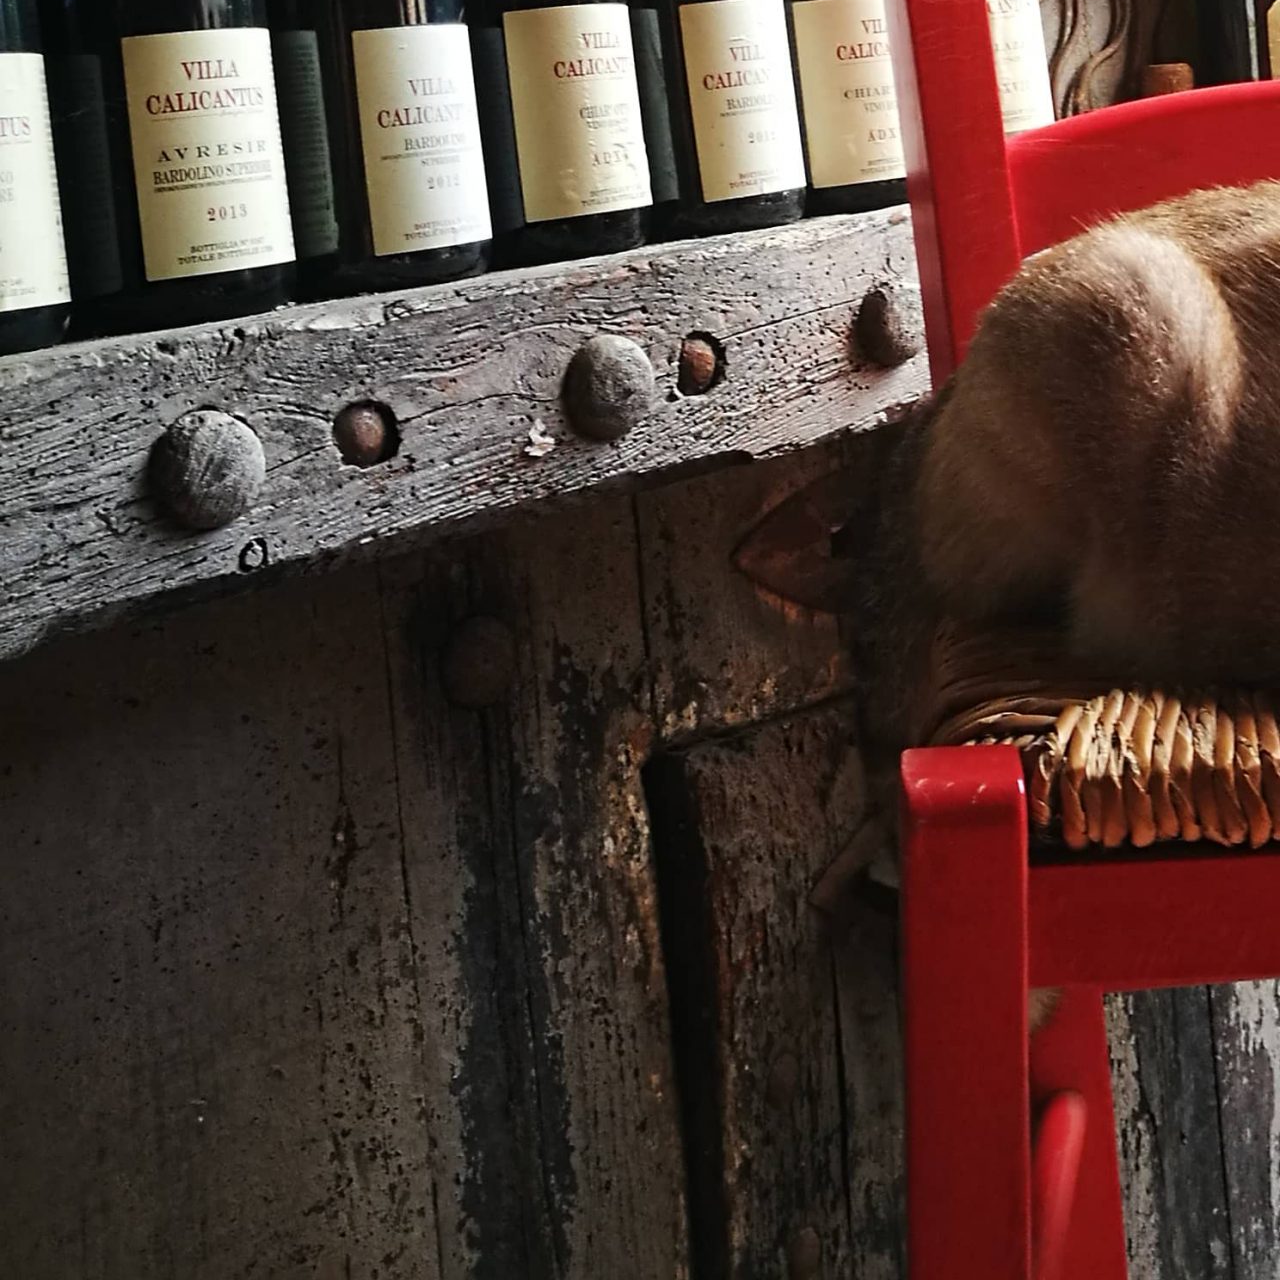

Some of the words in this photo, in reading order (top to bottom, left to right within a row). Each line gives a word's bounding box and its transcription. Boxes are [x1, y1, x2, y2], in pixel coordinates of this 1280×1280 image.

[180, 59, 240, 81] VILLA
[146, 86, 265, 115] CALICANTUS
[377, 103, 466, 129] CALICANT
[153, 164, 225, 186] BARDOLINO
